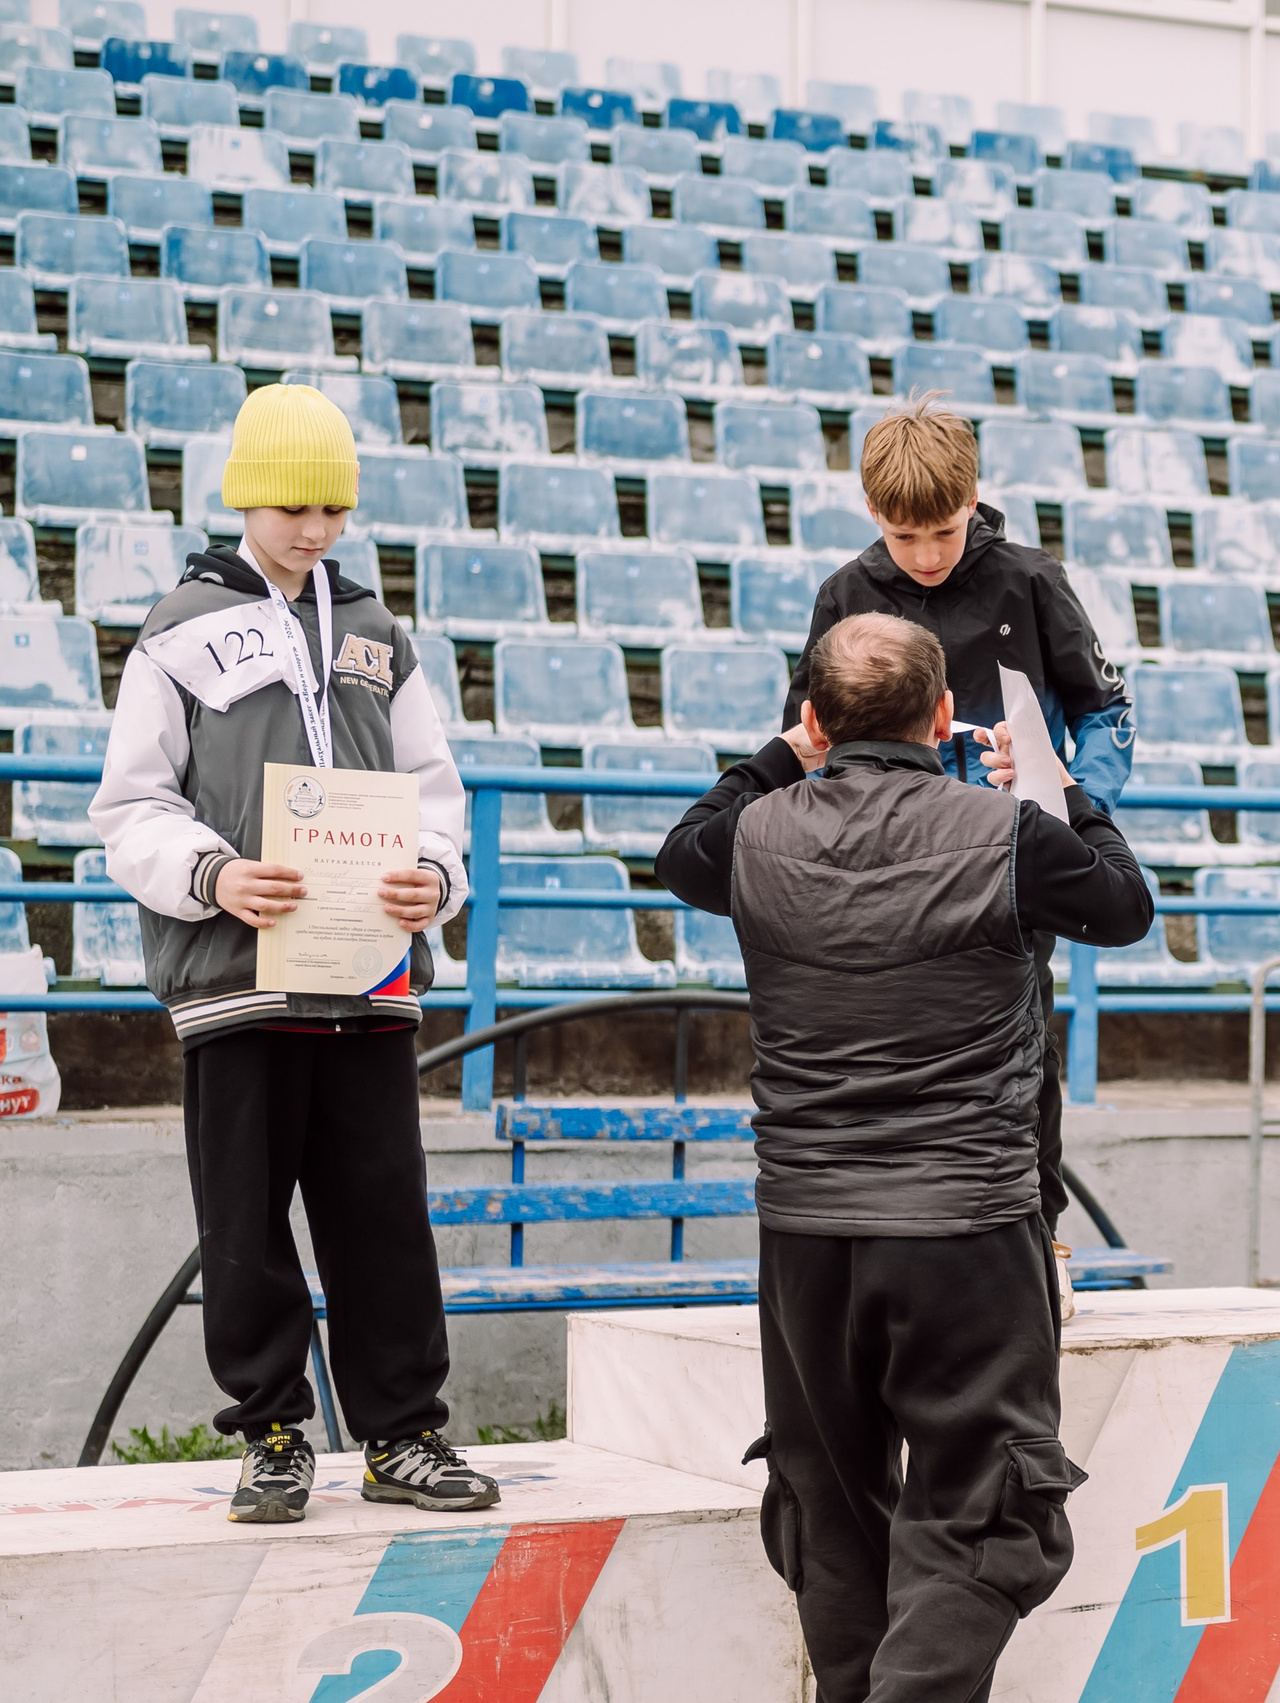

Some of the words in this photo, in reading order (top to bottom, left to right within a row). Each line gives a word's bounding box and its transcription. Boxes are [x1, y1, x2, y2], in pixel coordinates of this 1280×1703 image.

[202, 628, 274, 677] 122
[340, 676, 359, 685] NEW
[293, 828, 404, 848] ГРАМОТА
[314, 858, 382, 867] НАГРАЖДАЕТСЯ
[1136, 1477, 1232, 1627] 1
[296, 1612, 463, 1703] 2
